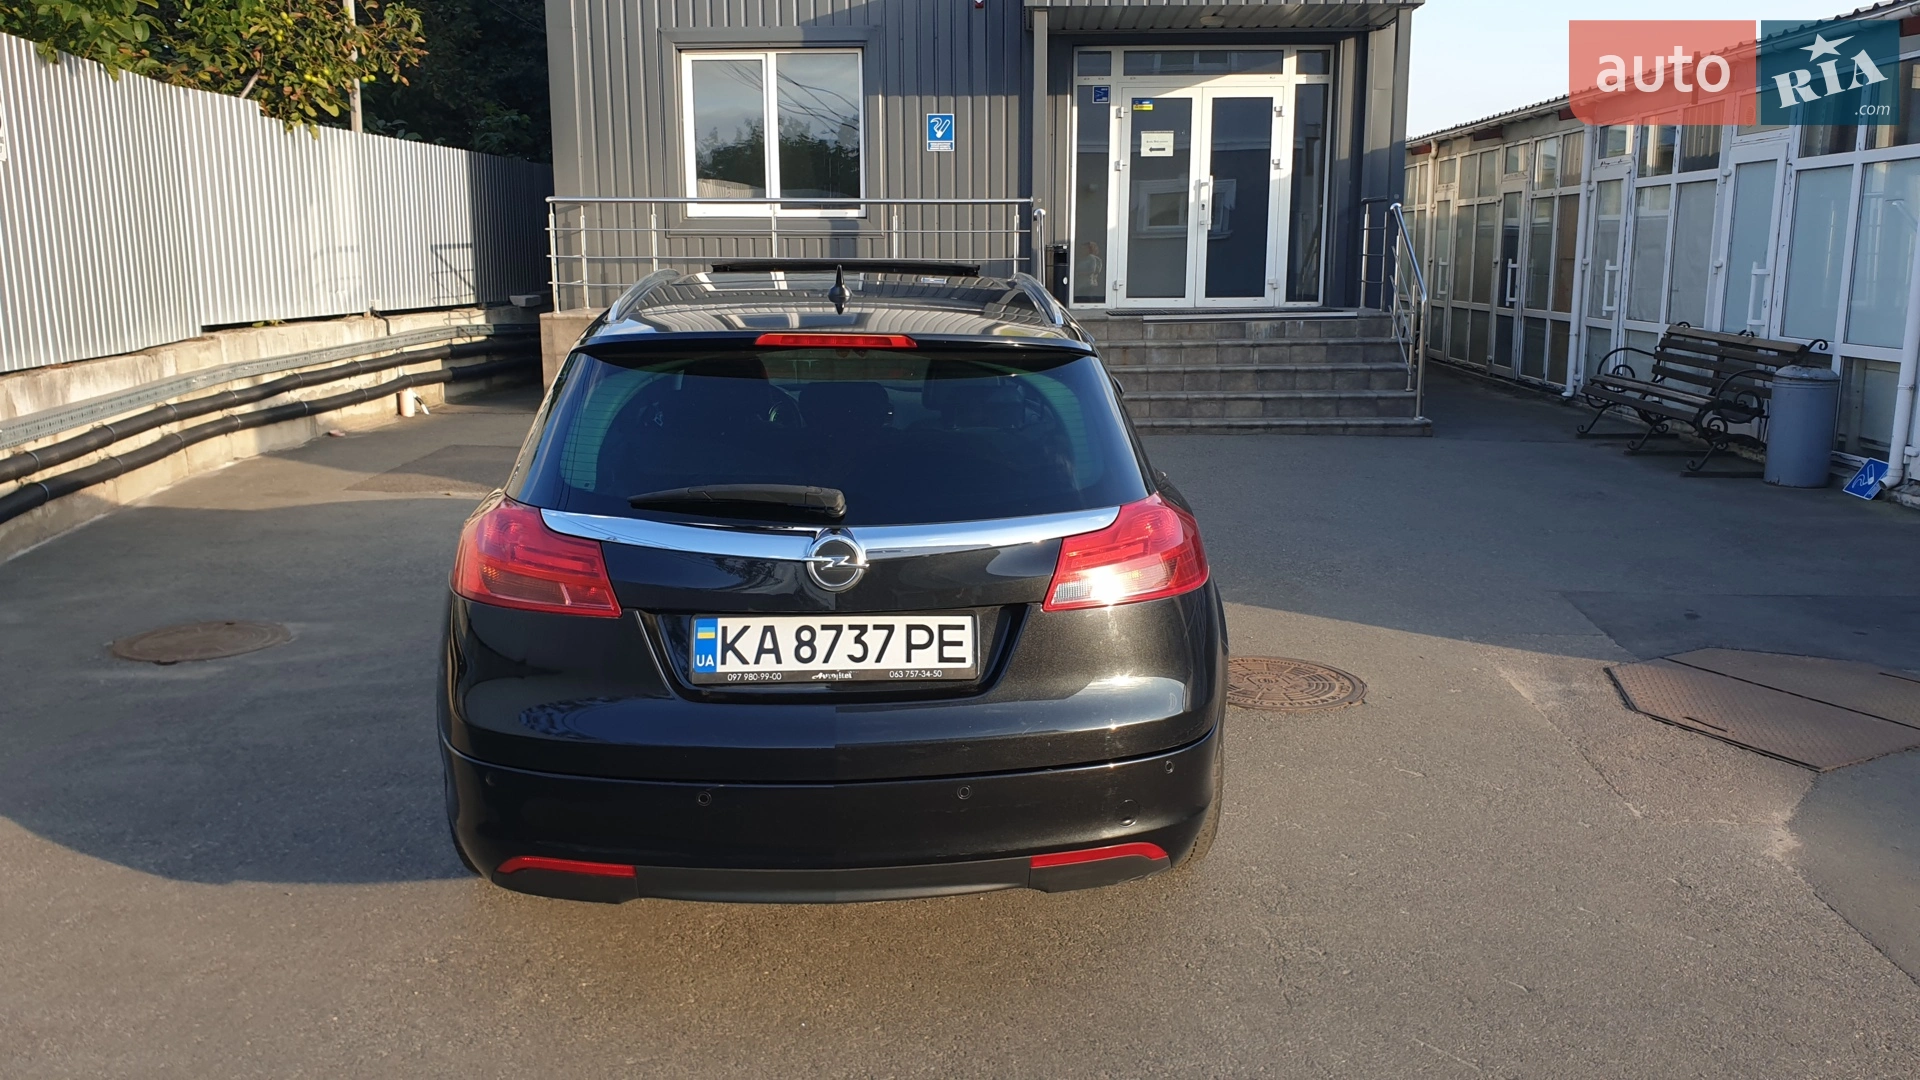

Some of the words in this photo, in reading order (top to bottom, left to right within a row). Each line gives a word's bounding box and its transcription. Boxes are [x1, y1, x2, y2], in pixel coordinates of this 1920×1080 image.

[720, 625, 783, 666] KA
[794, 624, 895, 664] 8737
[905, 624, 967, 664] PE
[696, 654, 715, 667] UA
[727, 673, 742, 682] 097
[743, 672, 782, 681] 980-99-00
[889, 670, 904, 678] 063
[905, 670, 943, 678] 757-34-50
